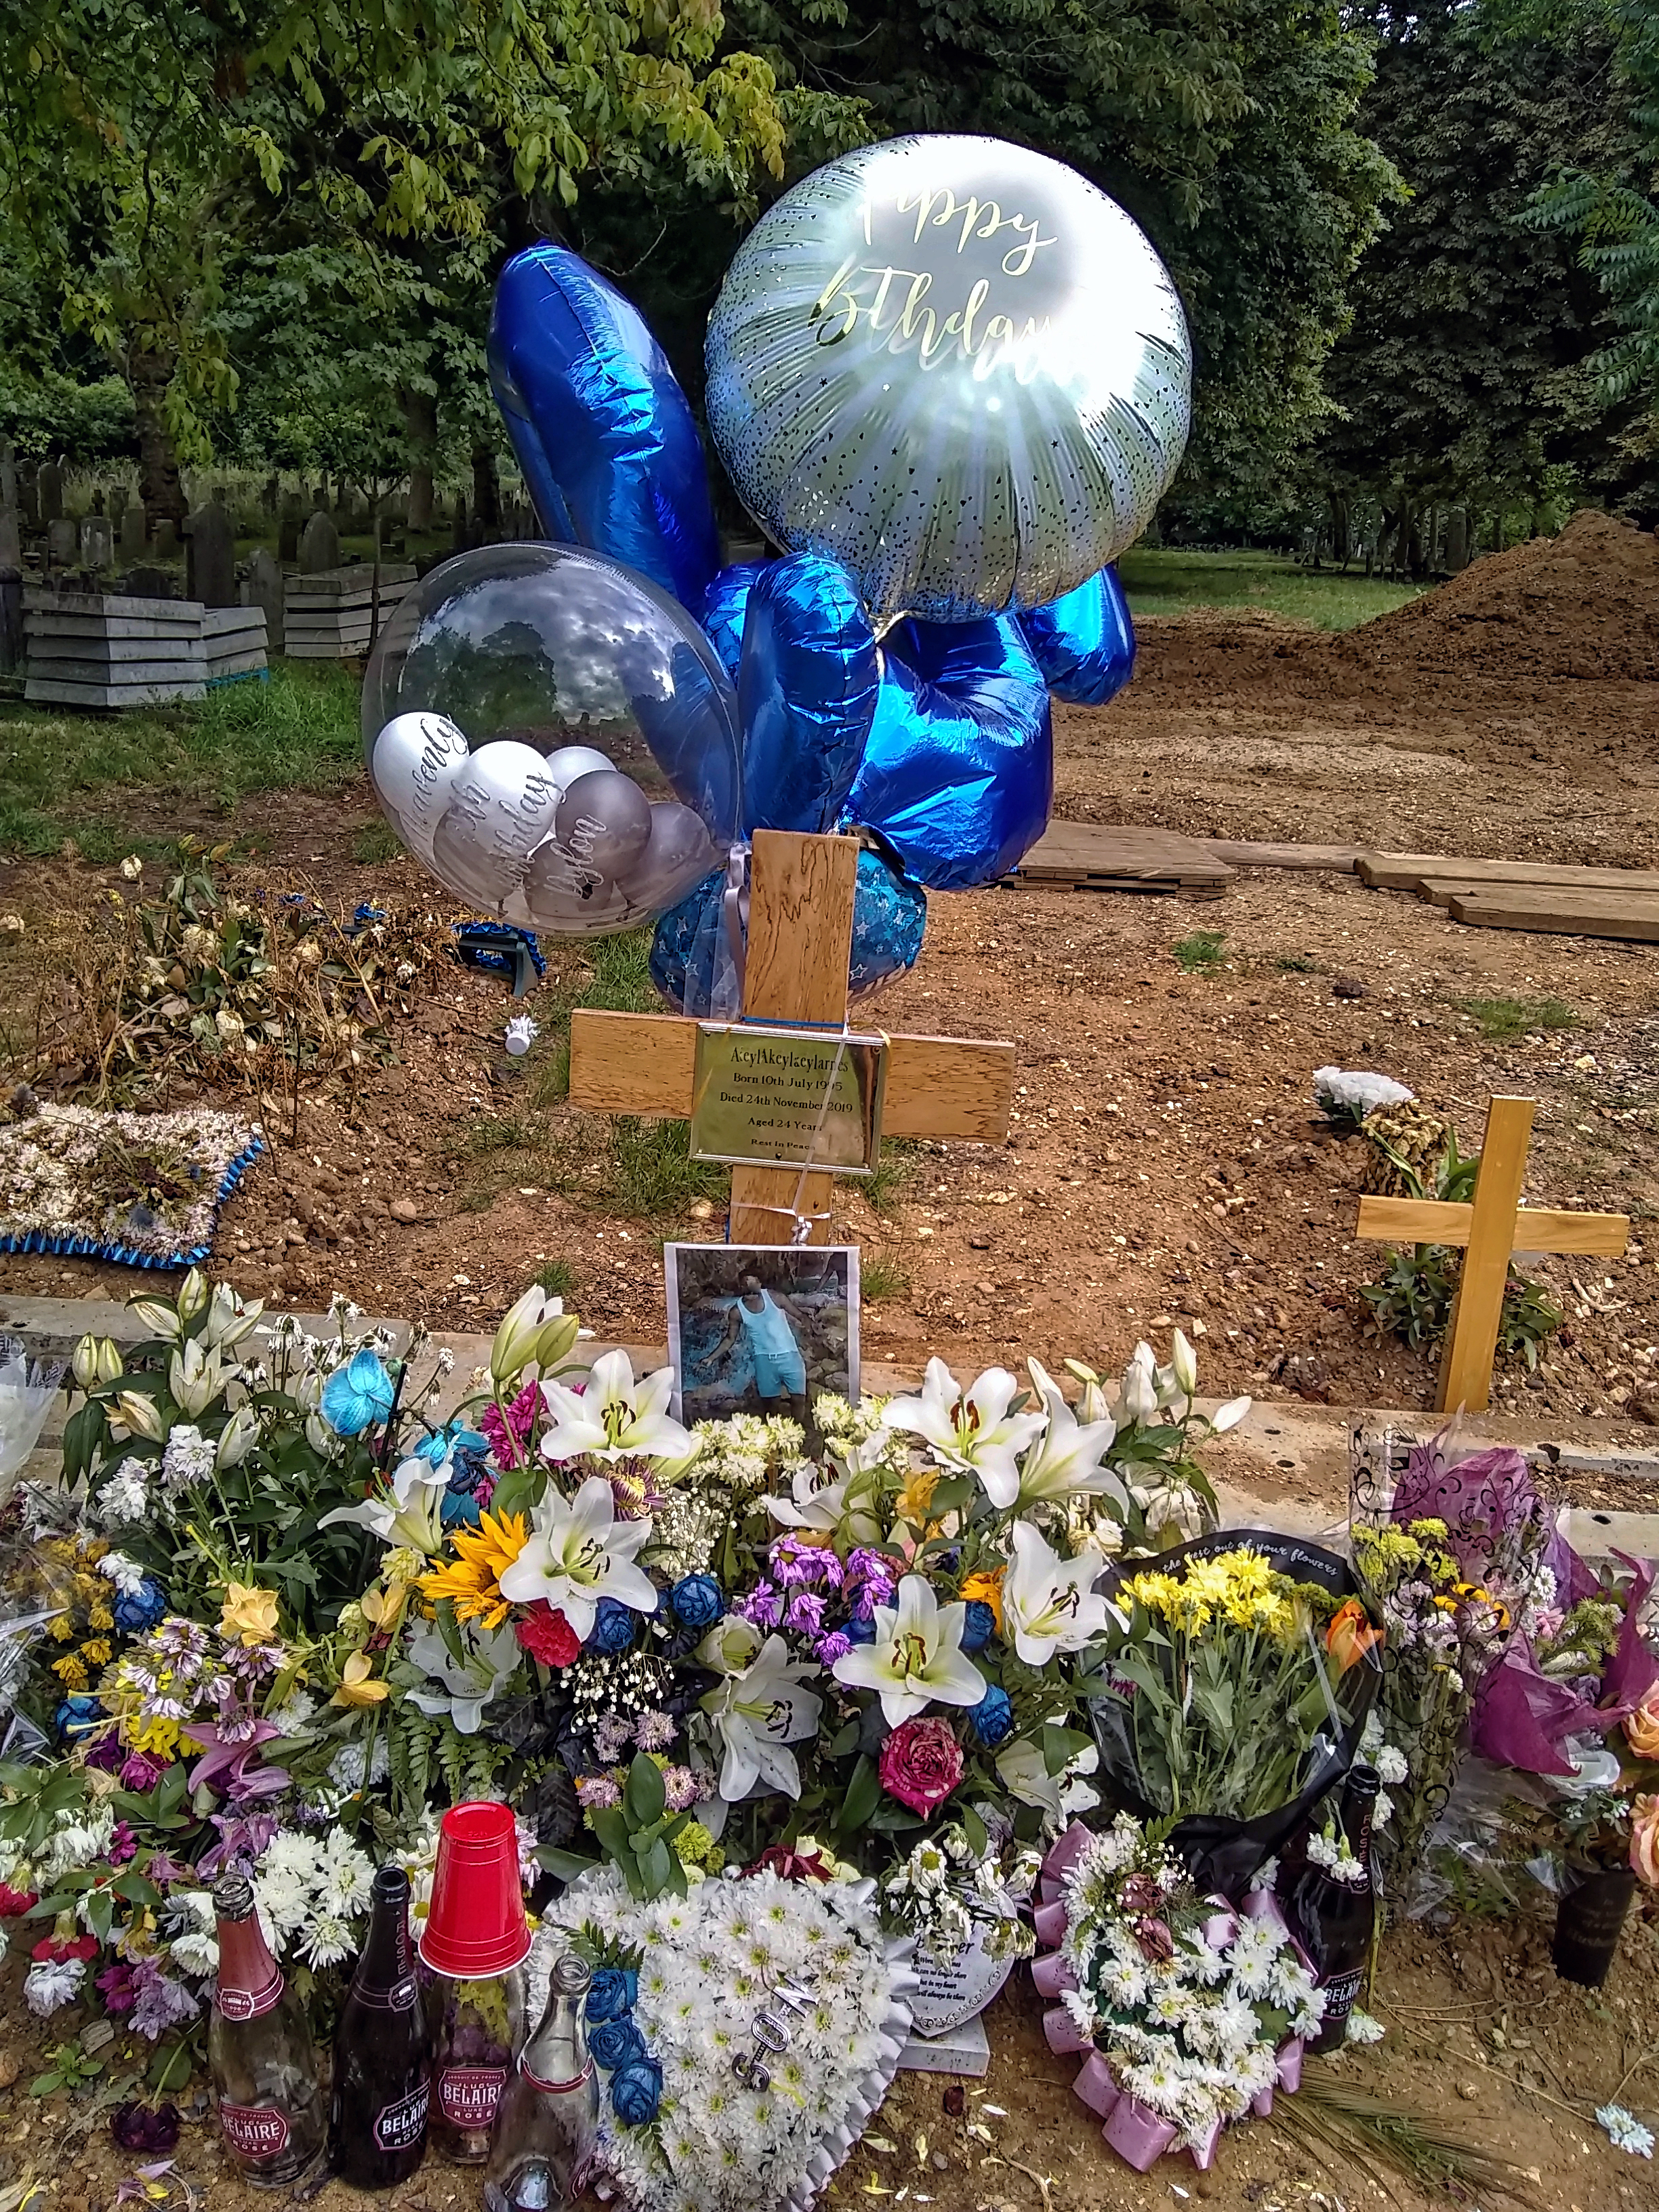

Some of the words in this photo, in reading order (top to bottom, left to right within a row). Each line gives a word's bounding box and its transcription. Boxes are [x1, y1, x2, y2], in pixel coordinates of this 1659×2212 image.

[733, 1073, 758, 1084] Born
[762, 1076, 784, 1086] 10th
[787, 1078, 813, 1090] July
[720, 1092, 743, 1103] Died
[746, 1094, 771, 1106] 24th
[827, 1102, 853, 1113] 2019
[748, 1118, 774, 1128] Aged
[777, 1120, 790, 1128] 24
[751, 1139, 772, 1147] Rest
[1162, 1559, 1181, 1572] the
[1214, 1540, 1234, 1553] out
[1237, 1538, 1253, 1551] of
[1256, 1542, 1288, 1555] your
[1290, 1548, 1338, 1576] flowers
[221, 2112, 280, 2140] BELAIRE
